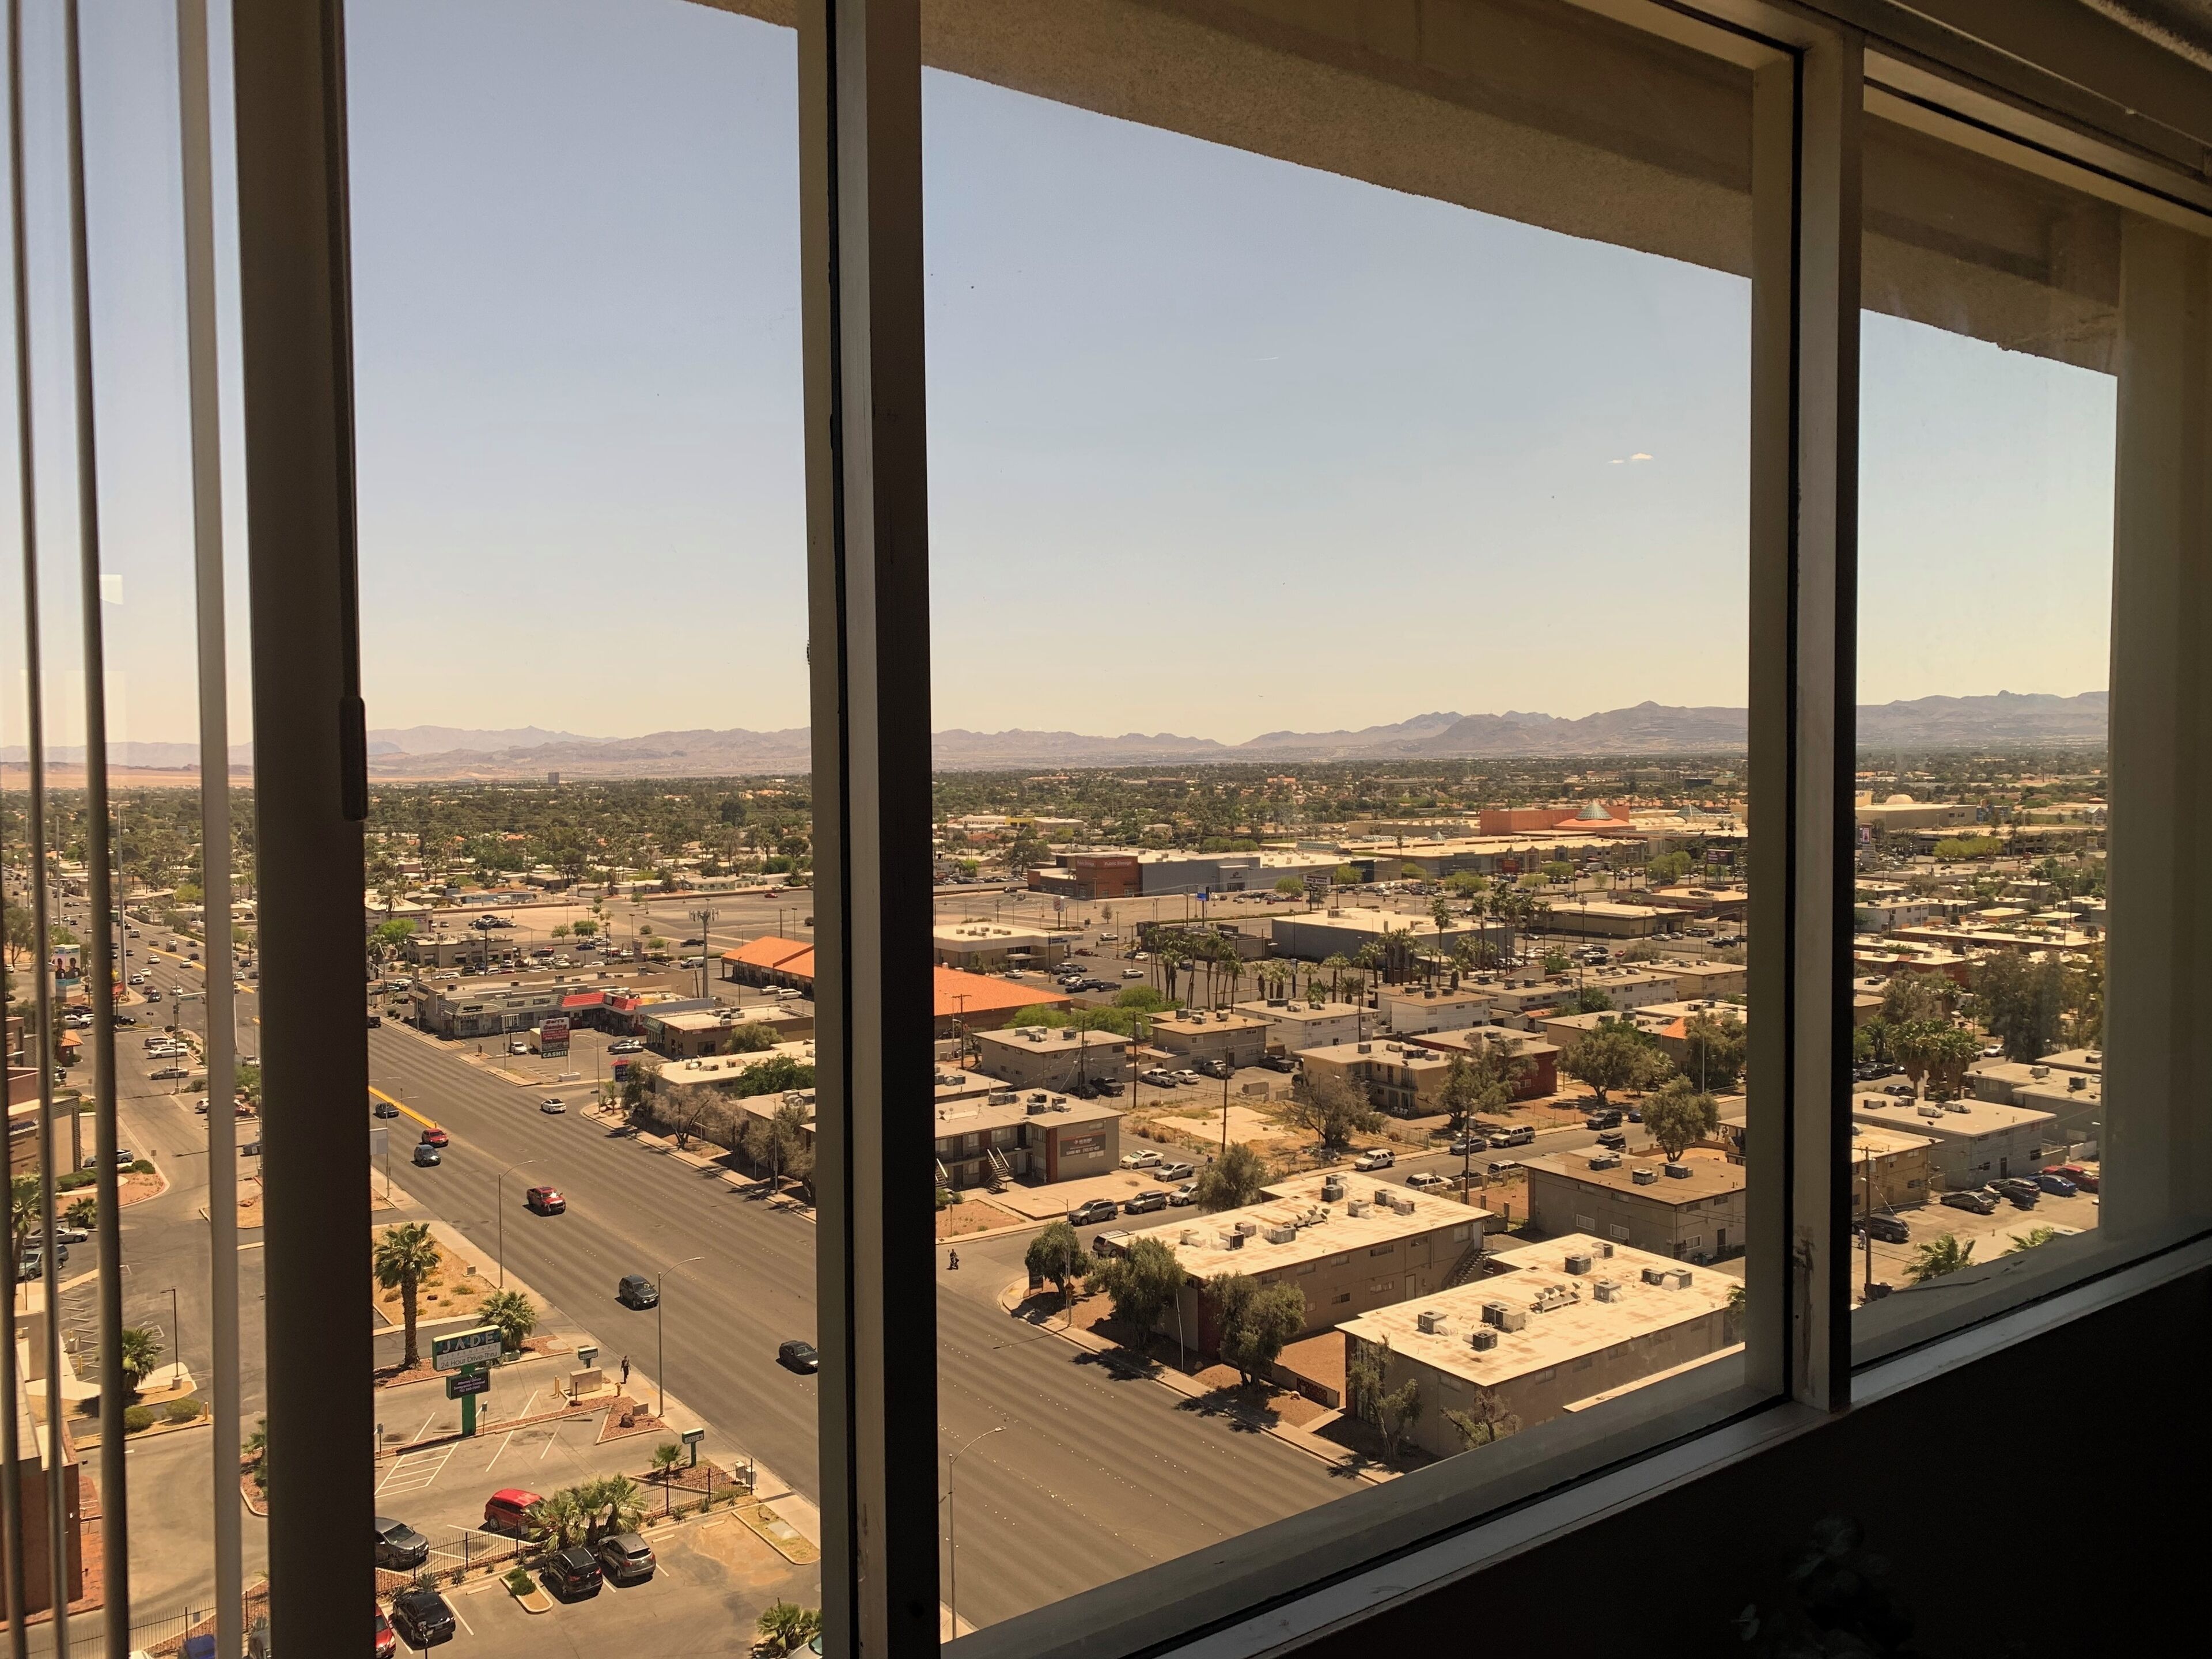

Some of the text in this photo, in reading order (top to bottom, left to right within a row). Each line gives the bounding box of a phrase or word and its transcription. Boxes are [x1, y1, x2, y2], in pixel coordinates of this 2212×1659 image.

[442, 1331, 494, 1353] JADE
[451, 1358, 466, 1366] Hour
[467, 1351, 497, 1363] Drive-Thru
